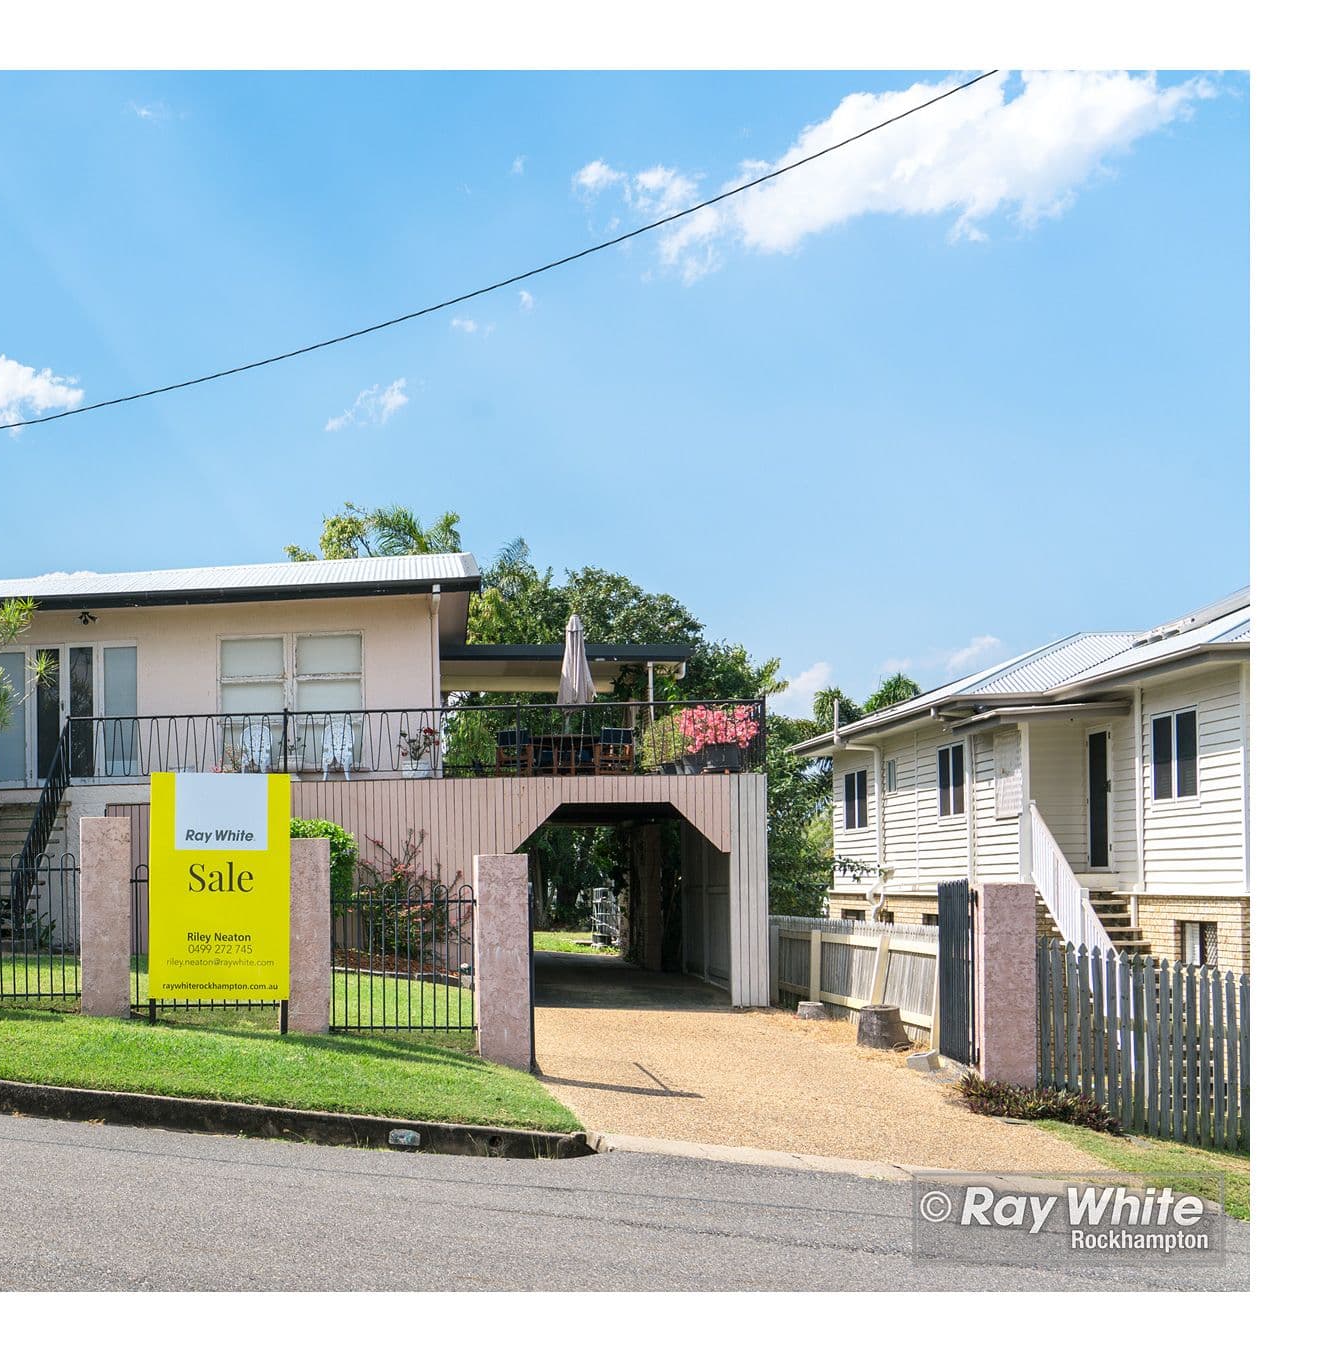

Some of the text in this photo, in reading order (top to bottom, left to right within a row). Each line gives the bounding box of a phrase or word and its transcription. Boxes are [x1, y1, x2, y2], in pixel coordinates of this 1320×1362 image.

[185, 829, 254, 844] Ray White
[188, 861, 254, 893] Sale
[187, 932, 251, 943] Riley Neaton
[188, 944, 253, 954] 0499 272 745
[166, 957, 275, 968] riley.neaton@raywhite.com
[162, 982, 278, 991] raywhiterockhampton.com.au
